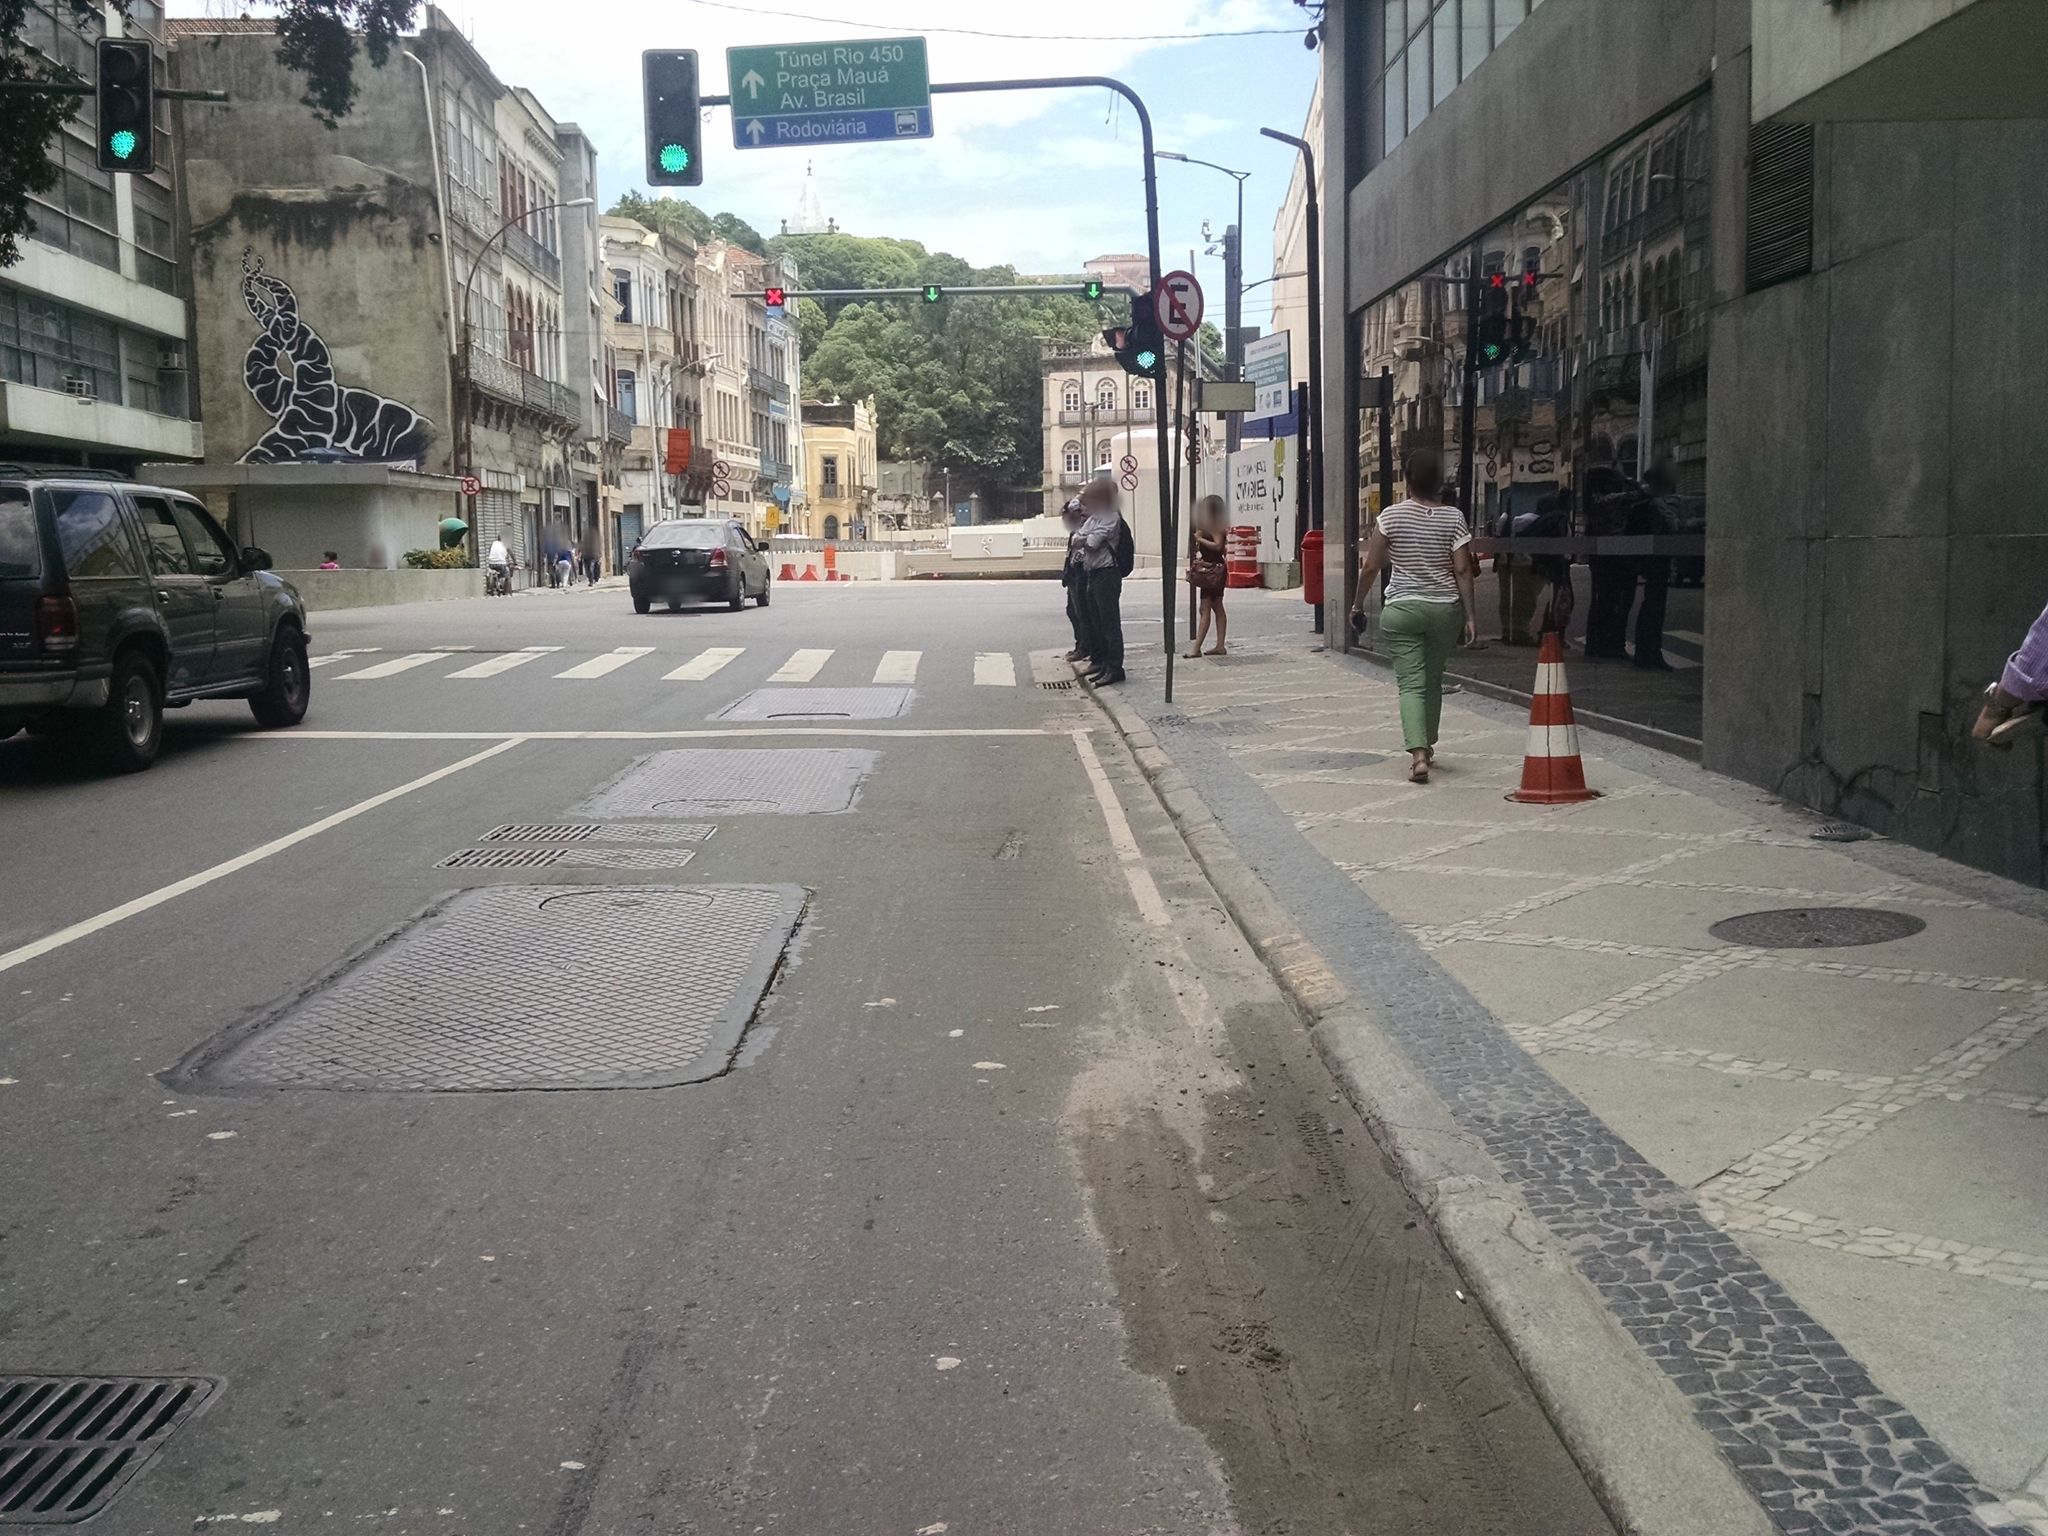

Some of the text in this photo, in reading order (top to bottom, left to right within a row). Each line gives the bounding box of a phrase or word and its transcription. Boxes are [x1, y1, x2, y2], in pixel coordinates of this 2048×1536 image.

[775, 44, 904, 68] Túnel Rio 450
[776, 66, 889, 91] Praça Mauá
[780, 87, 866, 109] Av. Brasil
[776, 117, 867, 139] Rodoviária
